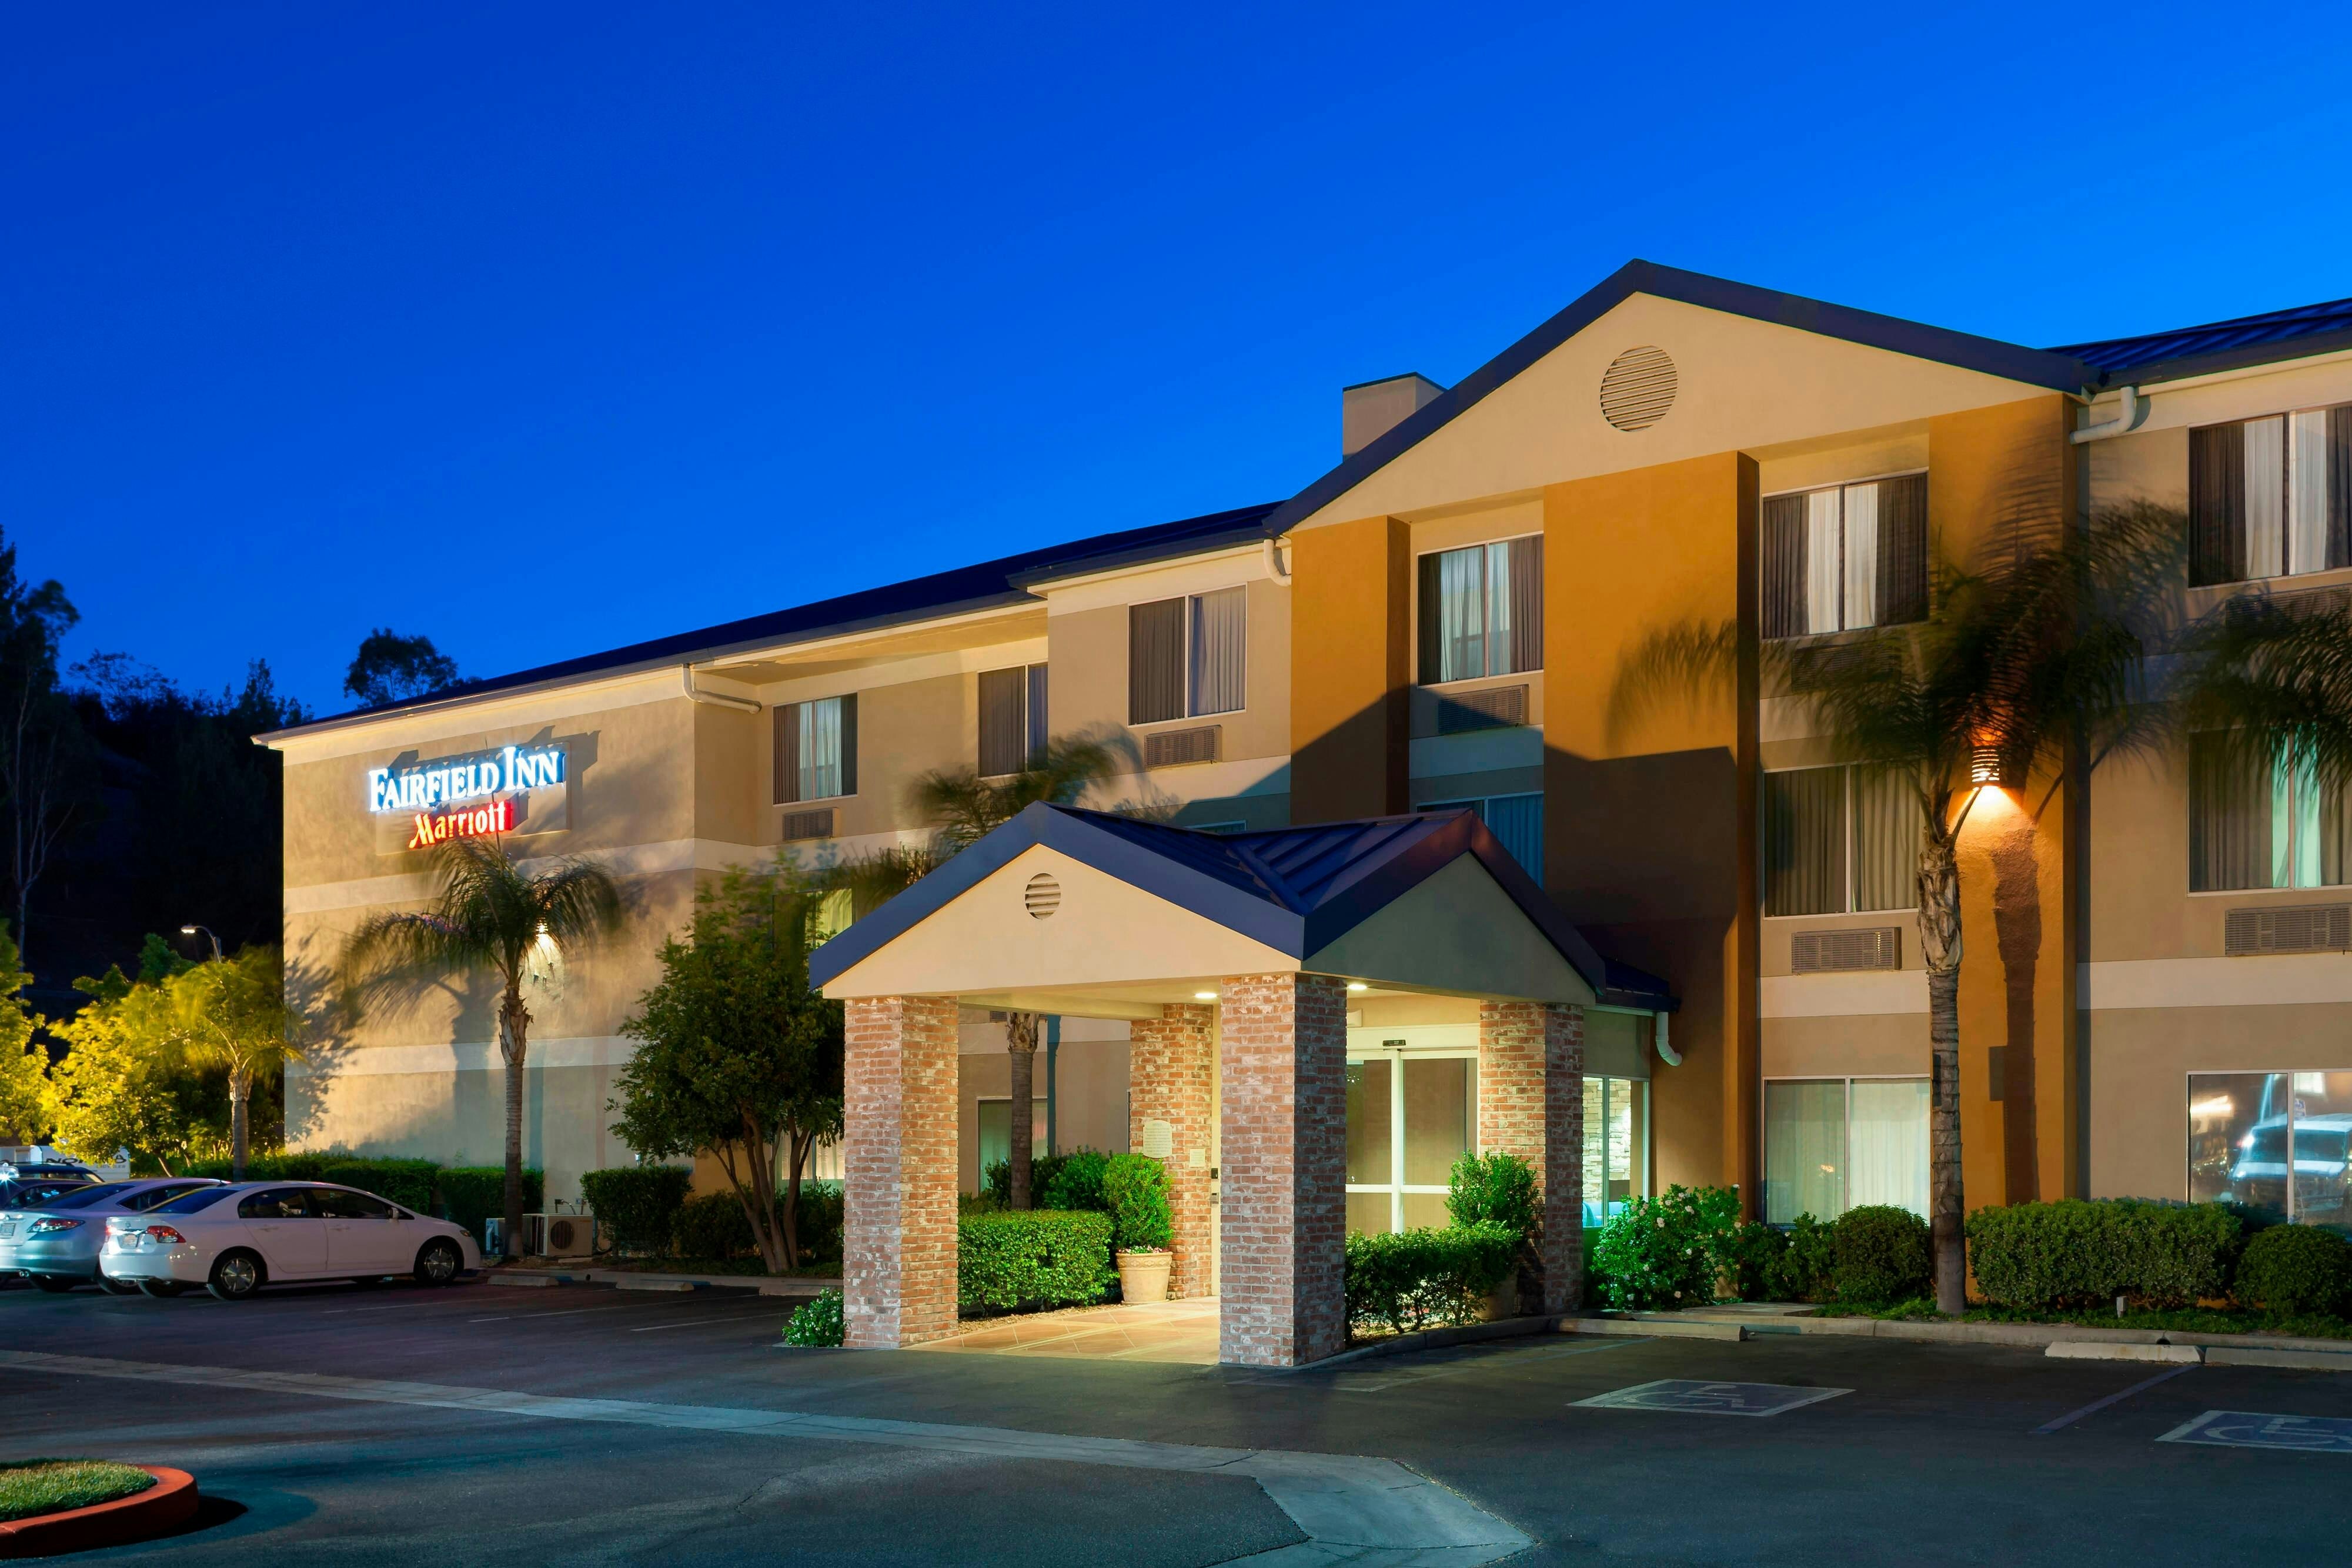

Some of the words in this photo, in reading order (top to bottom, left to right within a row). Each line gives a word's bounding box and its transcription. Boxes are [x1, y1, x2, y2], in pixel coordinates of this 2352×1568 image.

[369, 762, 500, 812] FAIRFIELD
[503, 745, 561, 791] INN
[408, 800, 506, 848] Marriott
